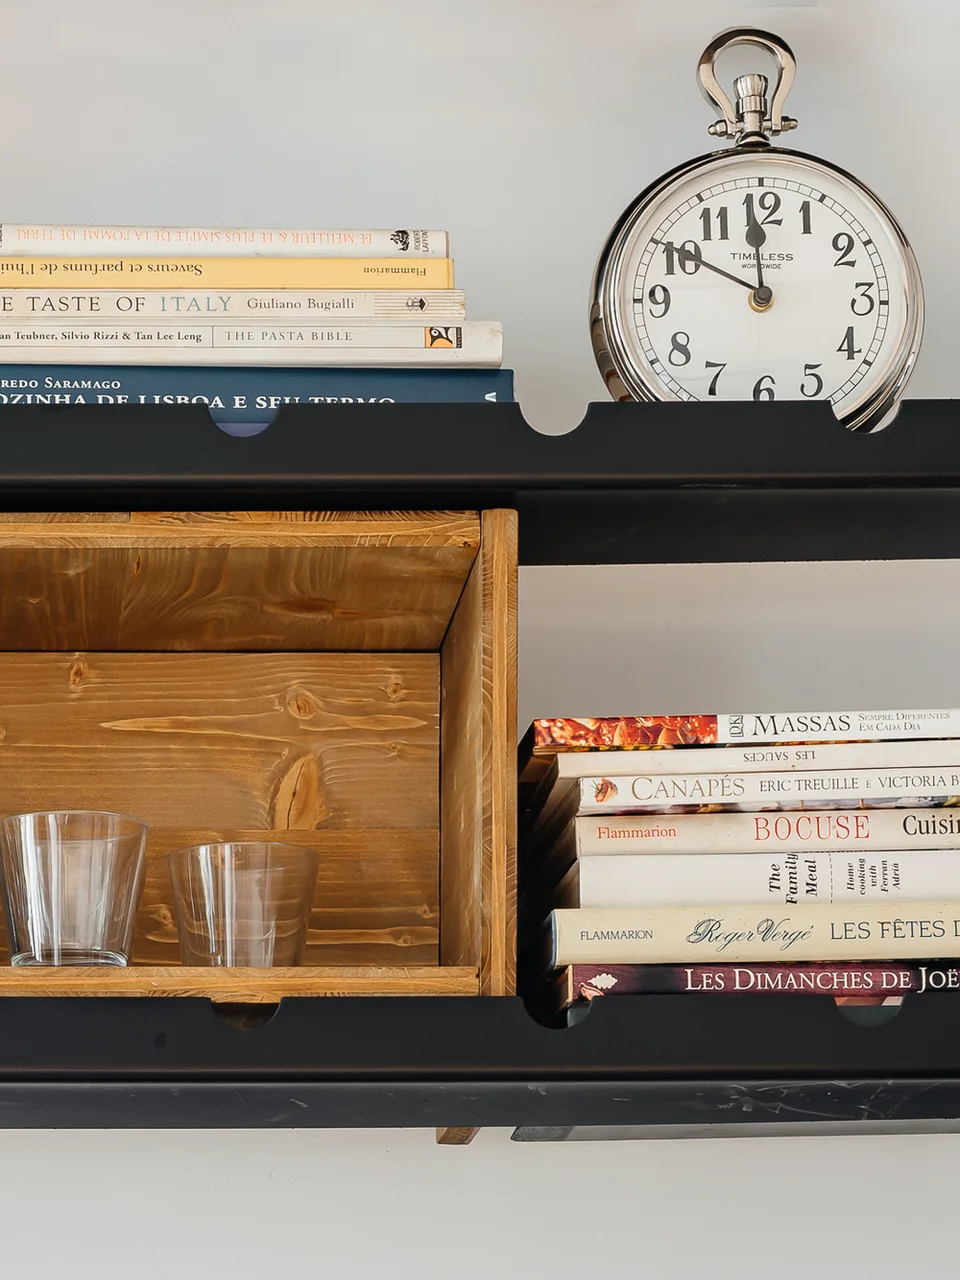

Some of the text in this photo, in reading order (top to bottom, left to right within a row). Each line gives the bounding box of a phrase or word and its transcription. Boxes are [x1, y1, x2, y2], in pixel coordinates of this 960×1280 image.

[742, 191, 783, 227] 12
[799, 200, 813, 235] 1
[699, 207, 730, 241] 11
[16, 228, 53, 241] TERRE
[60, 228, 76, 241] DE
[82, 229, 130, 242] POMME
[135, 230, 150, 241] LA
[155, 230, 171, 242] DE
[177, 230, 221, 243] SIMPLE
[225, 231, 255, 243] PLUS
[260, 232, 273, 243] LE
[278, 232, 288, 244] &
[291, 232, 355, 245] MEILLEUR
[360, 233, 373, 245] LE
[662, 240, 703, 275] 10
[730, 252, 794, 262] TIMELESS
[831, 232, 857, 267] 2
[40, 262, 58, 274] de
[62, 262, 124, 274] parfums
[128, 263, 143, 273] et
[147, 264, 204, 276] Saveurs
[363, 267, 427, 277] Flammarion
[26, 296, 101, 312] TASTE
[116, 296, 146, 312] OF
[160, 296, 232, 312] ITALY
[246, 297, 355, 313] Giuliano Bugialli
[648, 284, 671, 319] 9
[851, 282, 875, 317] 3
[14, 331, 58, 342] Teubner,
[61, 331, 90, 340] Silvio
[93, 331, 119, 340] Rizzi
[122, 331, 131, 340] &
[134, 331, 153, 340] Tan
[156, 331, 174, 340] Lee
[177, 331, 202, 343] Leng
[224, 331, 353, 341] THE PASTA BIBLE
[836, 326, 862, 361] 4
[668, 331, 692, 367] 8
[705, 361, 727, 396] 7
[800, 363, 824, 397] 5
[752, 375, 776, 402] 6
[233, 395, 247, 409] E
[730, 715, 742, 737] DK
[752, 714, 851, 736] MASSAS
[743, 750, 815, 762] LES SAUCES
[631, 776, 745, 801] CANAPÉS
[760, 779, 793, 792] ERIC
[795, 777, 859, 792] TREUILLE
[878, 775, 947, 788] VICTORIA
[951, 775, 960, 786] B
[597, 824, 677, 840] Flammarion
[753, 815, 871, 841] BOCUSE
[769, 863, 781, 893] The
[785, 852, 798, 905] Family
[804, 858, 817, 897] Meal
[847, 862, 855, 891] Home
[858, 858, 866, 895] cooking
[869, 865, 877, 887] with
[580, 929, 653, 941] FLAMMARION
[686, 918, 815, 952] Roger Vergé
[831, 922, 870, 940] LES
[880, 919, 946, 939] FÊTES
[684, 968, 725, 991] LES
[733, 967, 874, 990] DIMANCHES
[881, 972, 912, 989] DE
